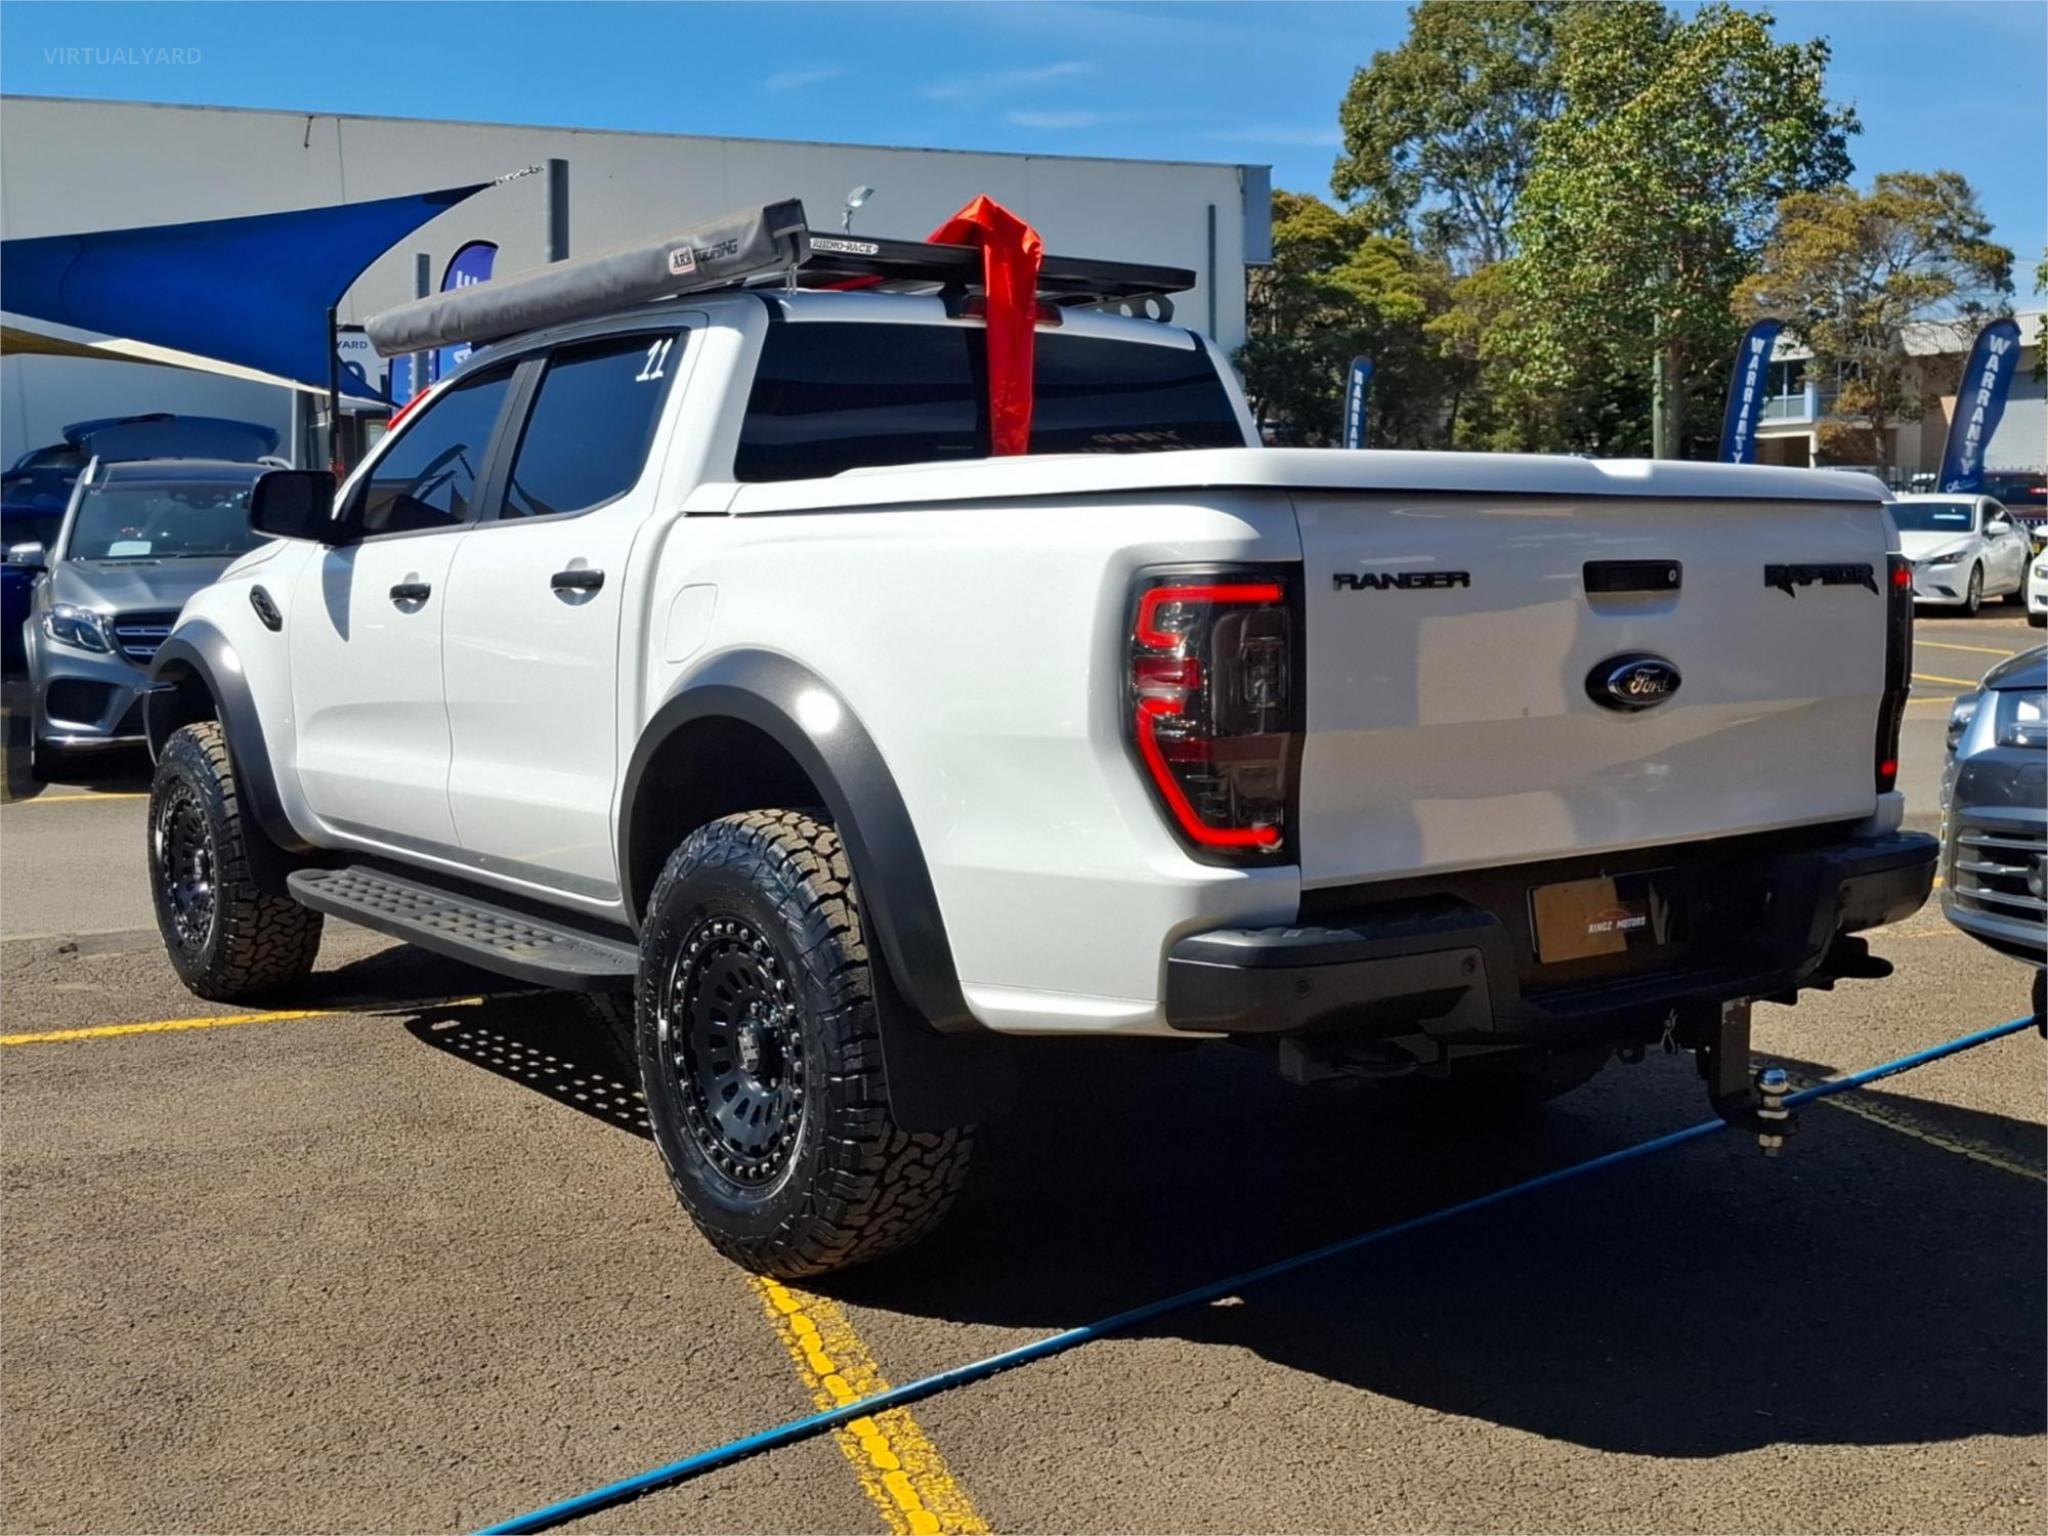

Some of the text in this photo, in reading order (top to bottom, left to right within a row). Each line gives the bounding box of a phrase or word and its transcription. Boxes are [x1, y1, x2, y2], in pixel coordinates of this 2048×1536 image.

[635, 337, 673, 382] 11
[1732, 336, 1765, 464] WARRANTY
[1960, 334, 2011, 475] WARRANTY
[1333, 571, 1470, 591] RANGER
[1764, 563, 1879, 599] RAPTOR
[1629, 668, 1669, 694] Ford
[1616, 916, 1646, 928] MOTORS
